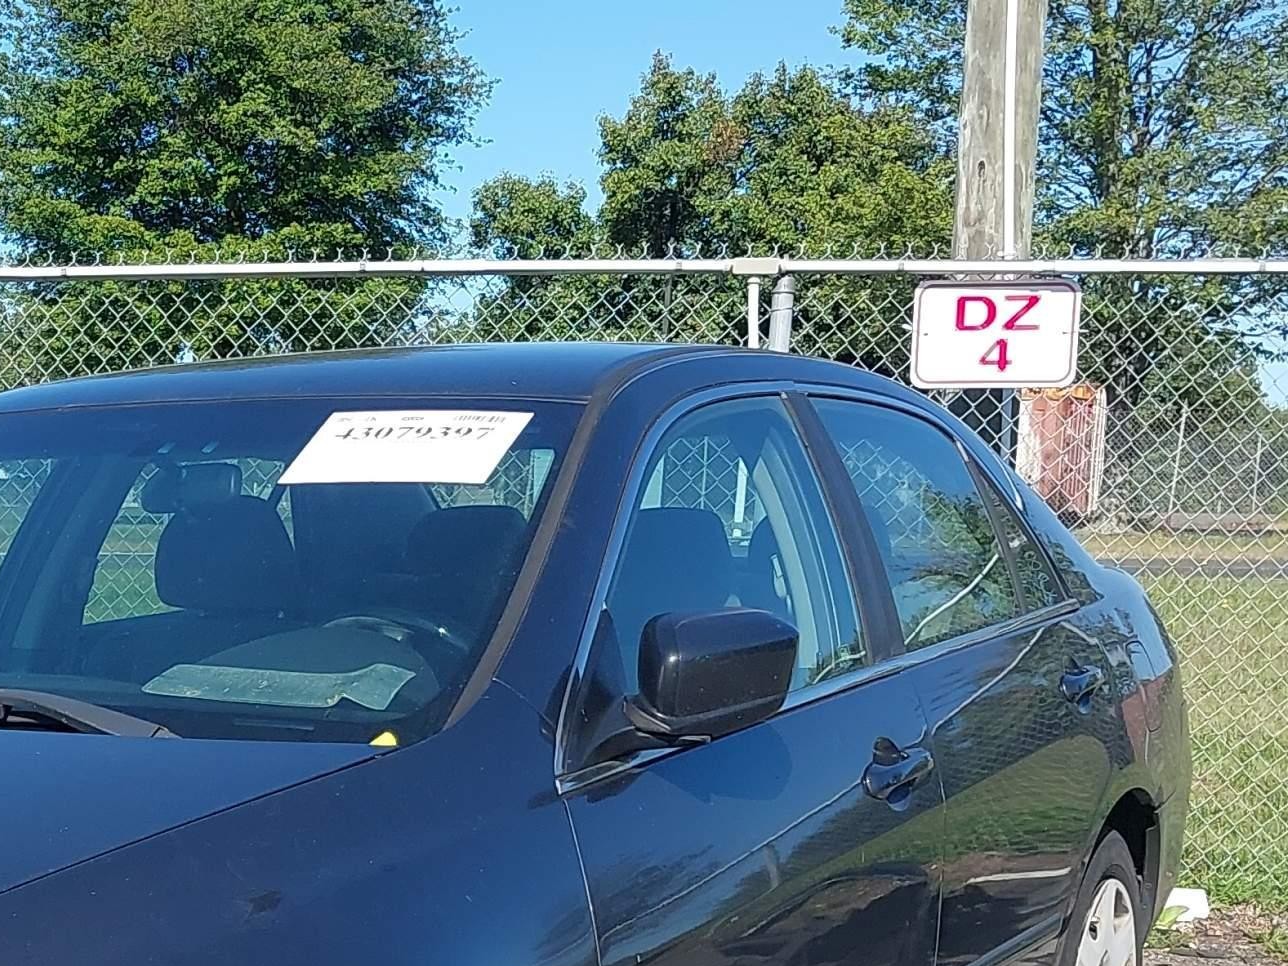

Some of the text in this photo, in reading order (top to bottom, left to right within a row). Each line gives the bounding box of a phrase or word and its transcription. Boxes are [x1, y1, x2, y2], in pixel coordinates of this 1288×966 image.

[956, 295, 1041, 332] DZ
[979, 338, 1013, 372] 4
[335, 426, 496, 440] 43079397
